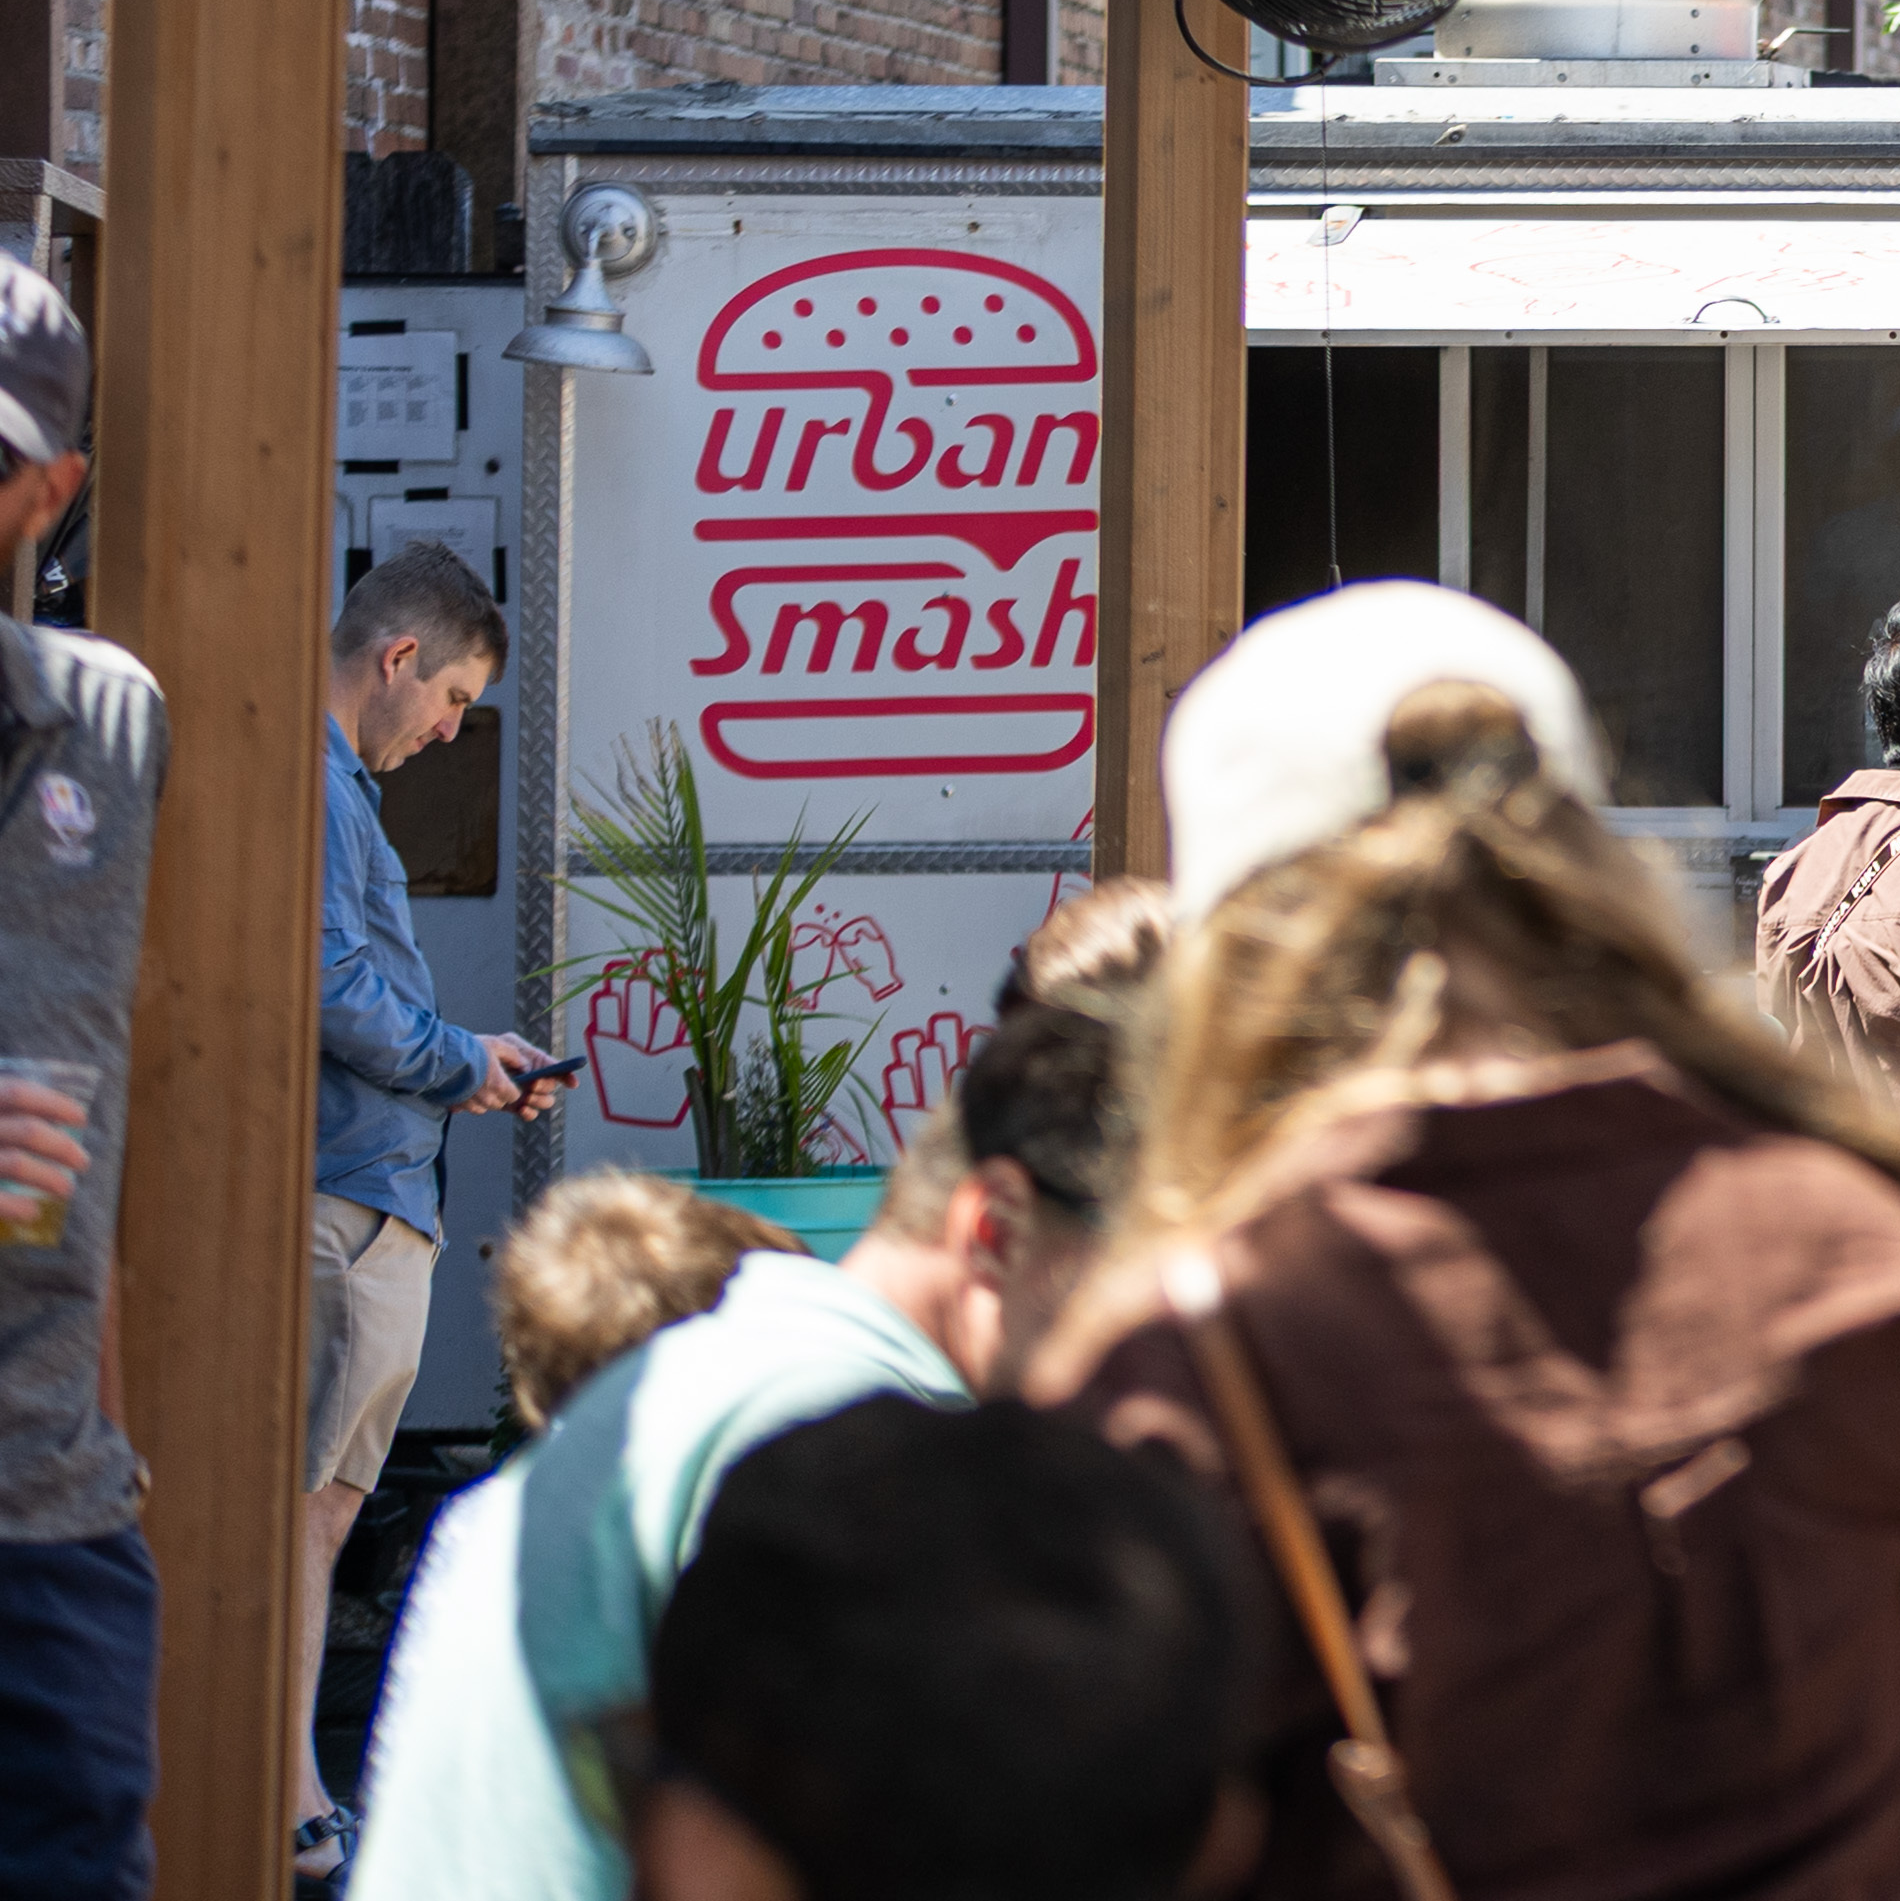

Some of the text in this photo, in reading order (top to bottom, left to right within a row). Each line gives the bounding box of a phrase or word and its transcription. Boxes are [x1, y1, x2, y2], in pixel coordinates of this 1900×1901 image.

[694, 399, 1099, 494] urban
[689, 557, 1096, 677] Smash
[1850, 860, 1881, 898] KIKI
